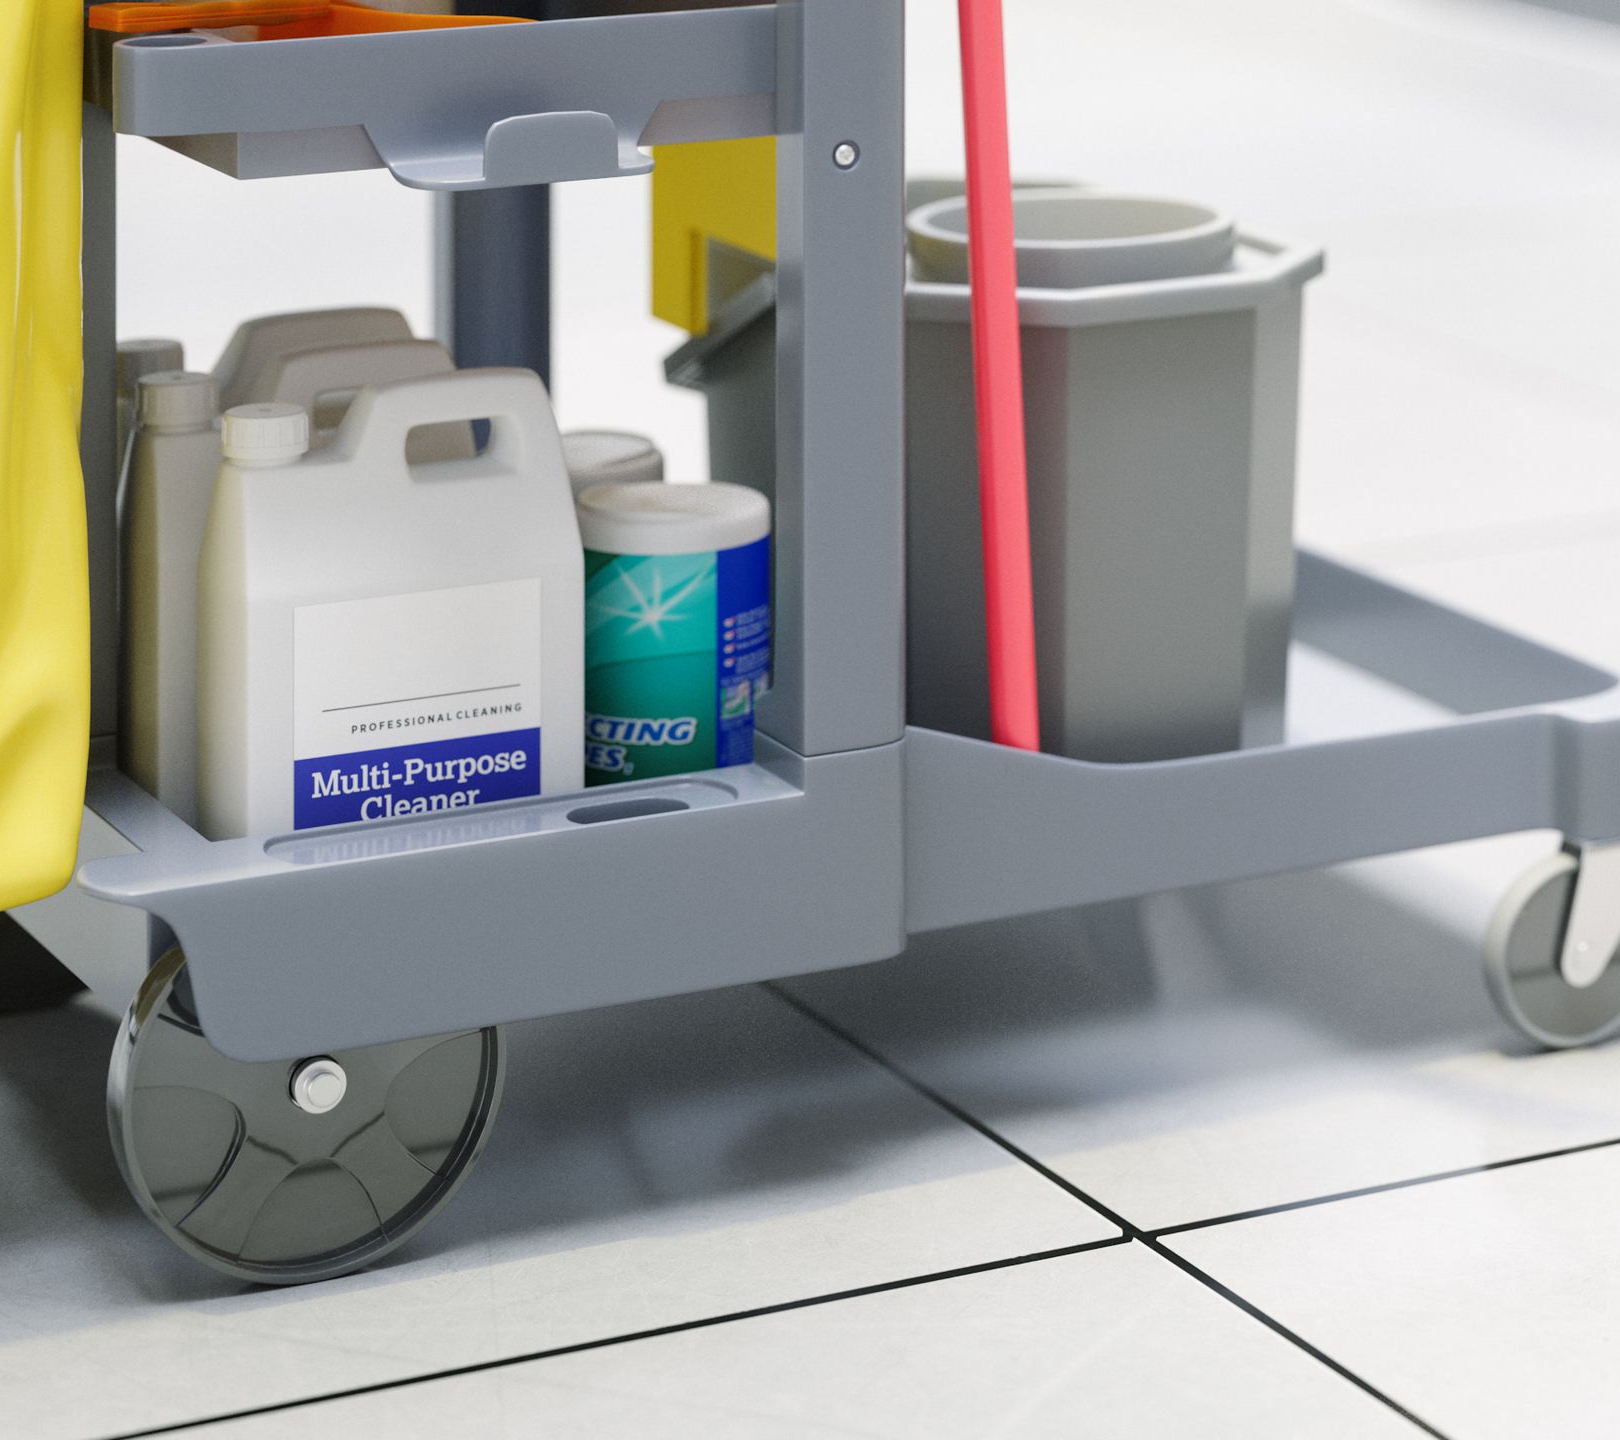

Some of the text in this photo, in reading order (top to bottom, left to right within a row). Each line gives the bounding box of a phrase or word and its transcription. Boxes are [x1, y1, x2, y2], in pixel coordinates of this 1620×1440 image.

[351, 703, 522, 734] PROFESSIONAL CLEANING
[586, 745, 624, 769] ES
[311, 750, 527, 799] Multi-Purpose
[360, 788, 481, 821] Cleaner
